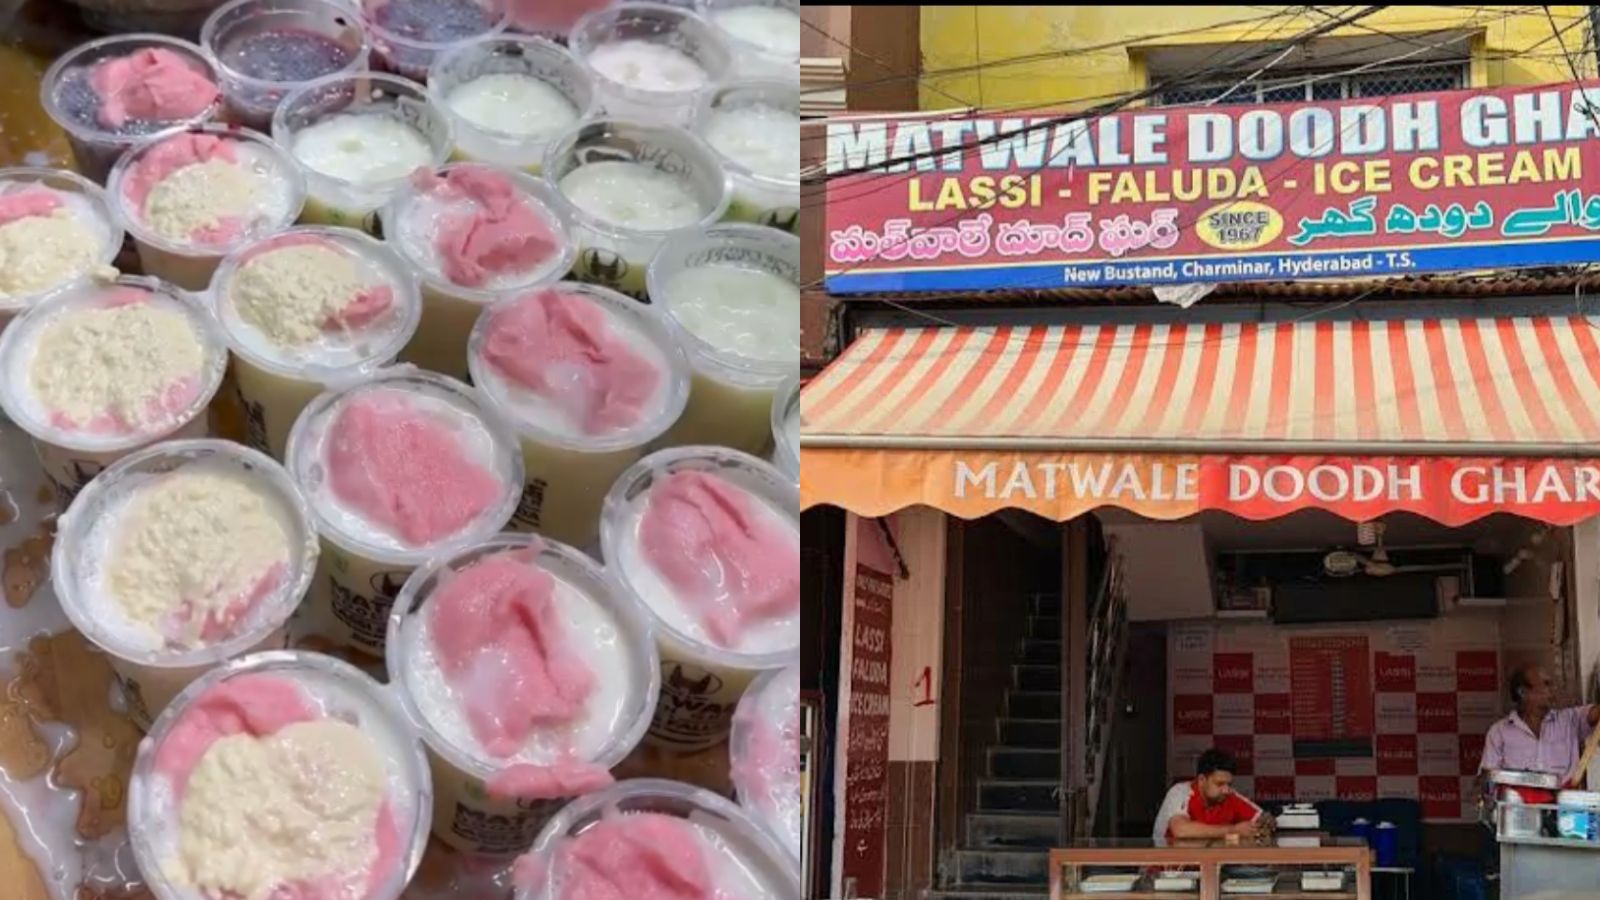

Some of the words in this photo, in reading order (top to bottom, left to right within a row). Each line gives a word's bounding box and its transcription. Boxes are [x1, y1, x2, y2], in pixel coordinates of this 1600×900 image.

[826, 115, 1168, 174] MATWALE
[1188, 101, 1440, 162] DOODH
[908, 174, 1042, 211] LASSI
[1088, 166, 1269, 206] FALUDA
[1314, 159, 1393, 195] ICE
[1408, 147, 1582, 190] CREAM
[1208, 210, 1270, 228] SINCE
[1217, 225, 1264, 244] 1967
[1287, 195, 1378, 245] گھر
[1385, 200, 1494, 238] دودھ
[1064, 267, 1100, 282] New
[1105, 262, 1178, 281] Bustand,
[1182, 257, 1274, 278] Charminar,
[1278, 253, 1373, 276] Hyderabad
[1386, 252, 1417, 269] T.S.
[953, 459, 1199, 500] MATWALE
[1229, 464, 1422, 502] DOODH
[1451, 465, 1600, 504] GHAR
[855, 623, 886, 653] LASSI
[852, 656, 888, 686] FALUDA
